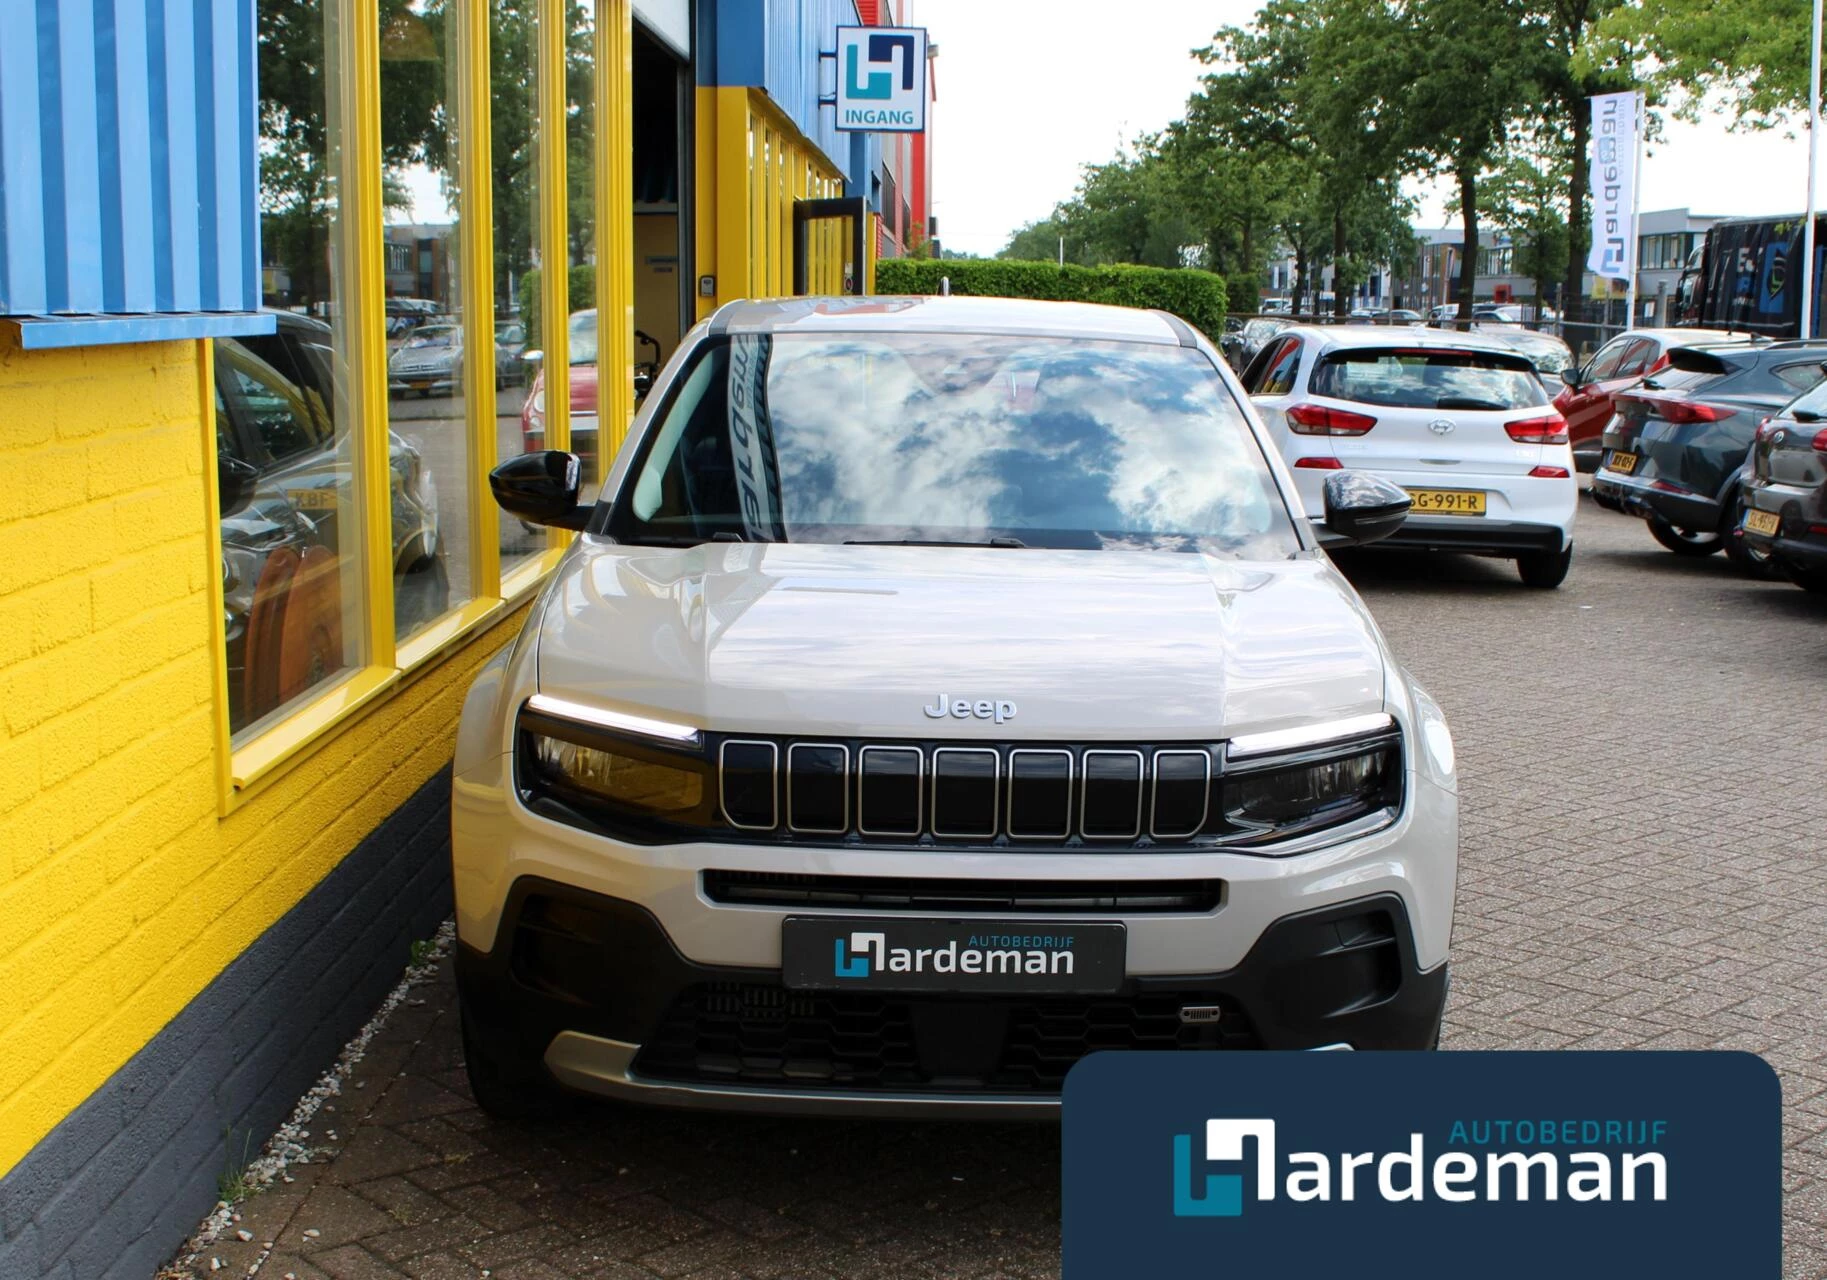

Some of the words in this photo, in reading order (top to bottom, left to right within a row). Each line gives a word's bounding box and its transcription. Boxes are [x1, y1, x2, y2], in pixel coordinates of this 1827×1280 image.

[845, 109, 914, 125] INGANG
[1410, 492, 1477, 509] SG-991-R
[923, 693, 1017, 724] Jeep
[968, 935, 1074, 948] AUTOBEDRIJF
[835, 932, 1074, 977] Hardeman
